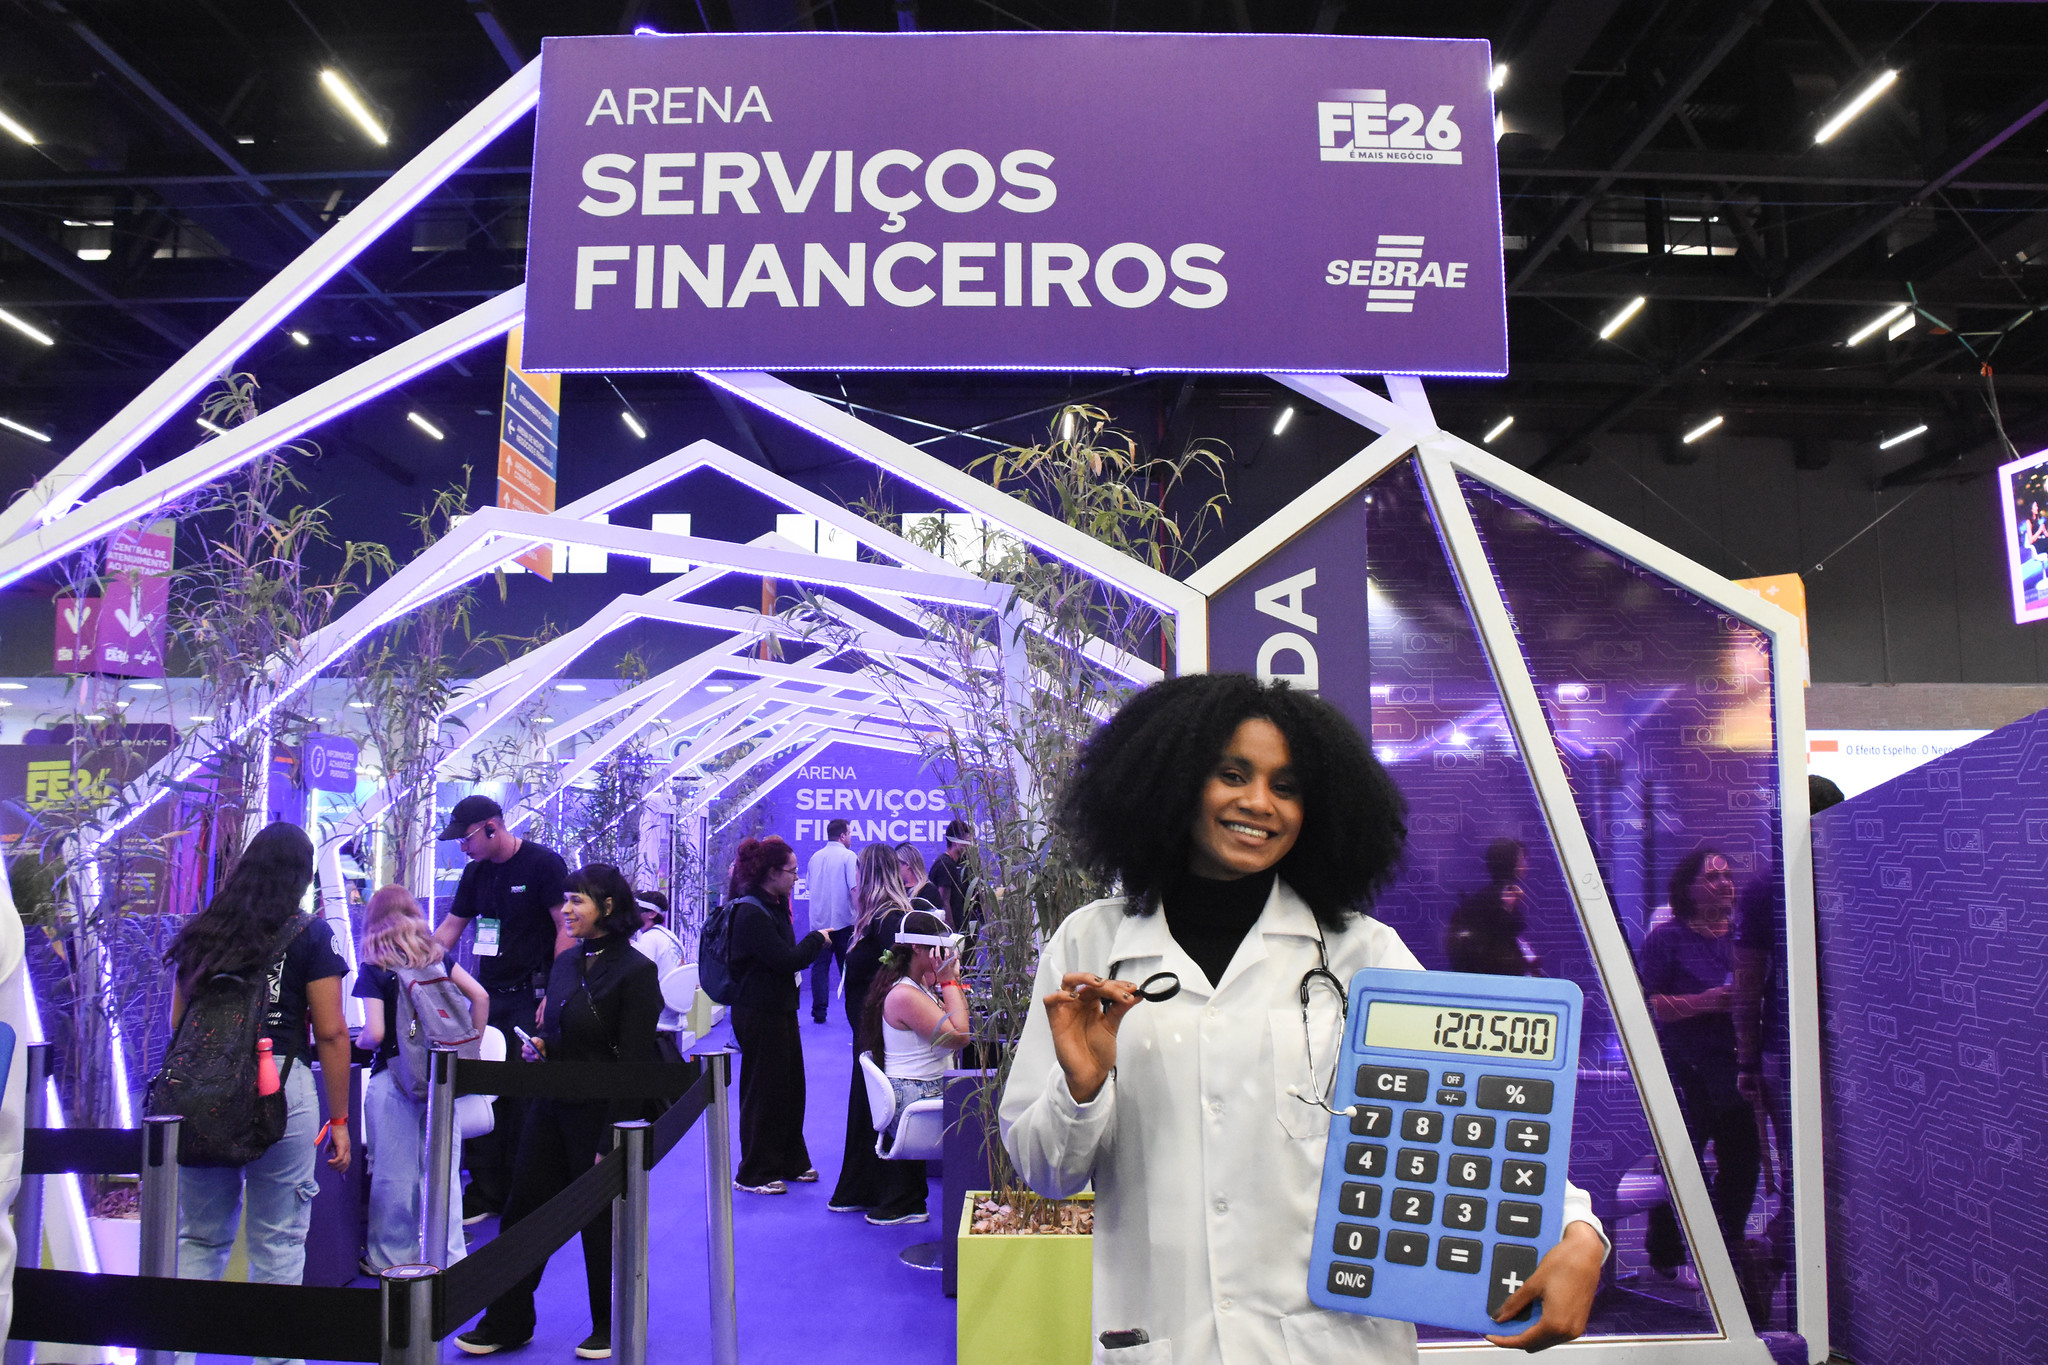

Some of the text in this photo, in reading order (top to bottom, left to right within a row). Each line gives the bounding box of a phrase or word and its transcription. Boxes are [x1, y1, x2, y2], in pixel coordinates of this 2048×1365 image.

[585, 85, 773, 126] ARENA
[1317, 101, 1462, 151] FE26
[1349, 149, 1356, 159] É
[1386, 151, 1434, 161] NEGÓCIO
[578, 149, 1058, 233] SERVIÇOS
[574, 241, 1229, 310] FINANCEIROS
[1325, 259, 1469, 288] SEBRAE
[114, 543, 167, 559] CENTRAL DE
[107, 562, 121, 571] AO
[1846, 745, 1853, 755] O
[1856, 744, 1881, 755] Efeito
[1882, 744, 1919, 757] Espelho:
[1922, 744, 1929, 755] O
[796, 766, 857, 780] ARENA
[796, 788, 946, 818] SERVIÇOS
[1433, 1012, 1550, 1055] 120.500
[1377, 1073, 1408, 1093] CE
[1446, 1075, 1460, 1084] OFF
[1366, 1112, 1380, 1130] 7
[1416, 1117, 1430, 1135] 8
[1467, 1122, 1482, 1141] 9
[1359, 1150, 1373, 1169] 4
[1410, 1156, 1425, 1175] 5
[1462, 1162, 1477, 1181] 6
[1355, 1191, 1366, 1210] 1
[1405, 1197, 1420, 1216] 2
[1457, 1203, 1472, 1223] 3
[1348, 1231, 1363, 1250] 0
[1335, 1270, 1366, 1288] ON/C
